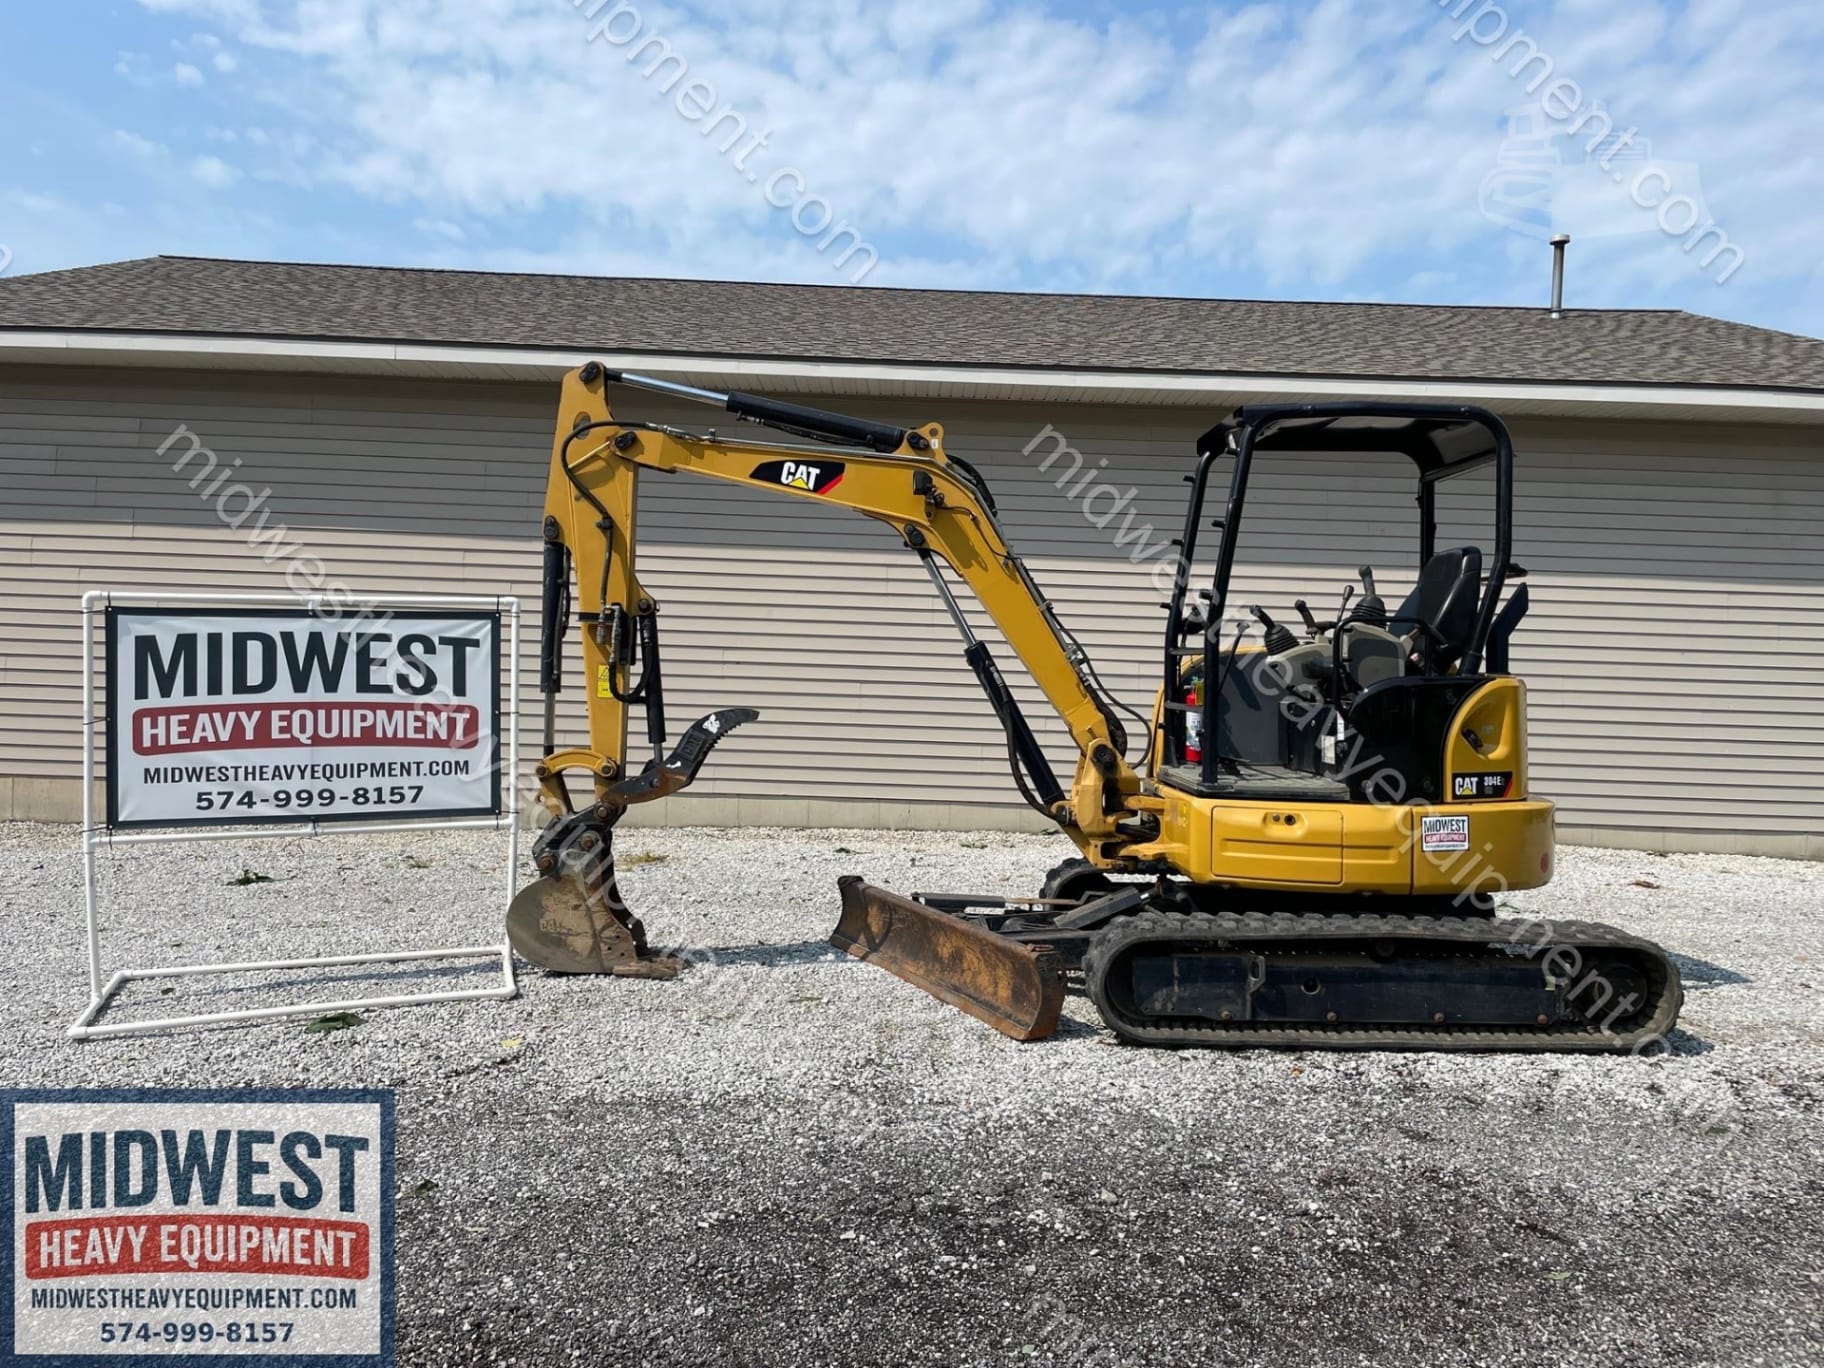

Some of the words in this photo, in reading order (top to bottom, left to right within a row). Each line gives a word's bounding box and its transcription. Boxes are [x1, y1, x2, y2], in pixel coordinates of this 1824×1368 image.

[781, 461, 821, 490] CAT
[134, 631, 481, 700] MIDWEST
[142, 710, 264, 748] HEAVY
[271, 709, 470, 745] EQUIPMENT
[143, 760, 470, 784] MIDWESTHEAVYEQUIPMENT.COM
[195, 785, 424, 810] 574-999-8157
[1455, 777, 1478, 795] CAT
[1424, 819, 1466, 833] MIDWEST
